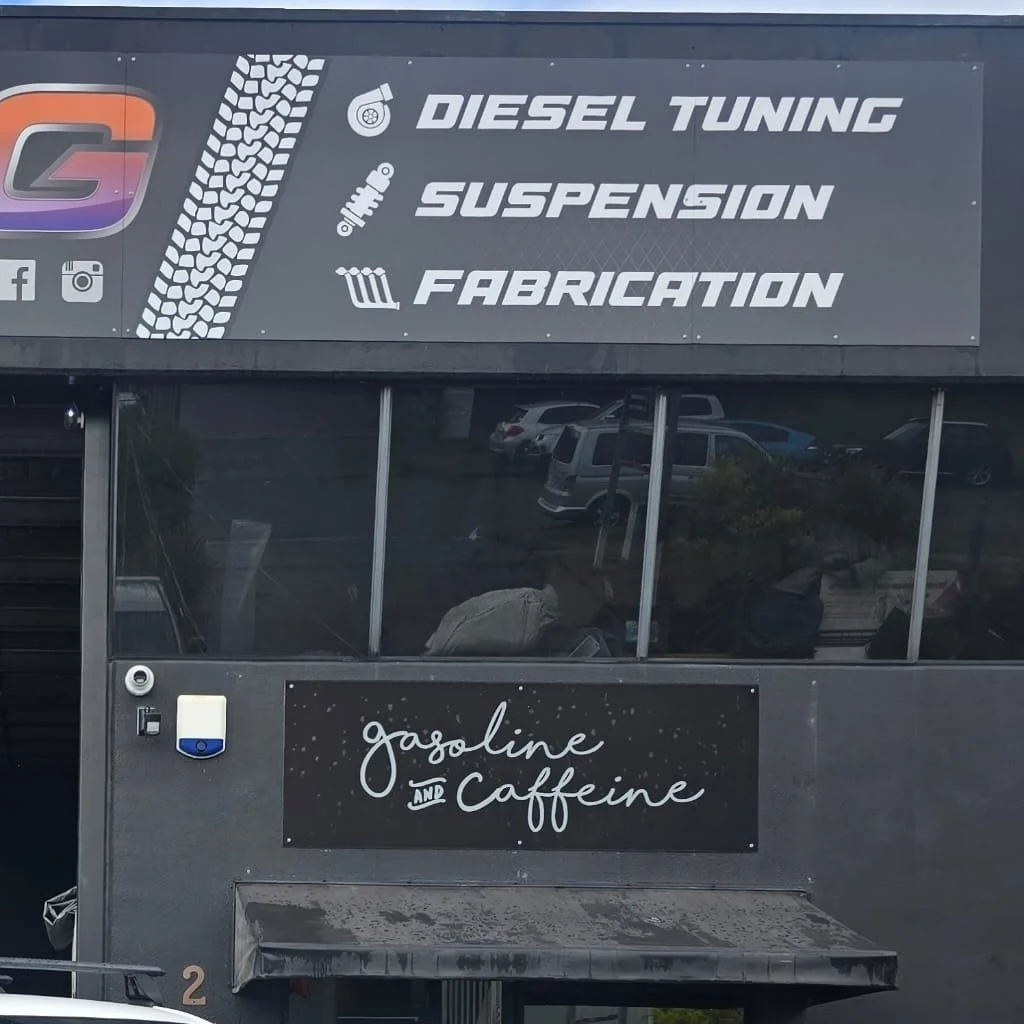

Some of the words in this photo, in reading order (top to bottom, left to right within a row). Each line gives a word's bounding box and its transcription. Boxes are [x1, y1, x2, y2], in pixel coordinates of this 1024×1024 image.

[416, 94, 646, 131] DIESEL
[669, 95, 904, 132] TUNING
[415, 182, 835, 220] SUSPENSION
[413, 269, 844, 308] FABRICATION
[360, 701, 605, 798] gasoline
[413, 784, 445, 804] AND
[182, 965, 207, 1005] 2
